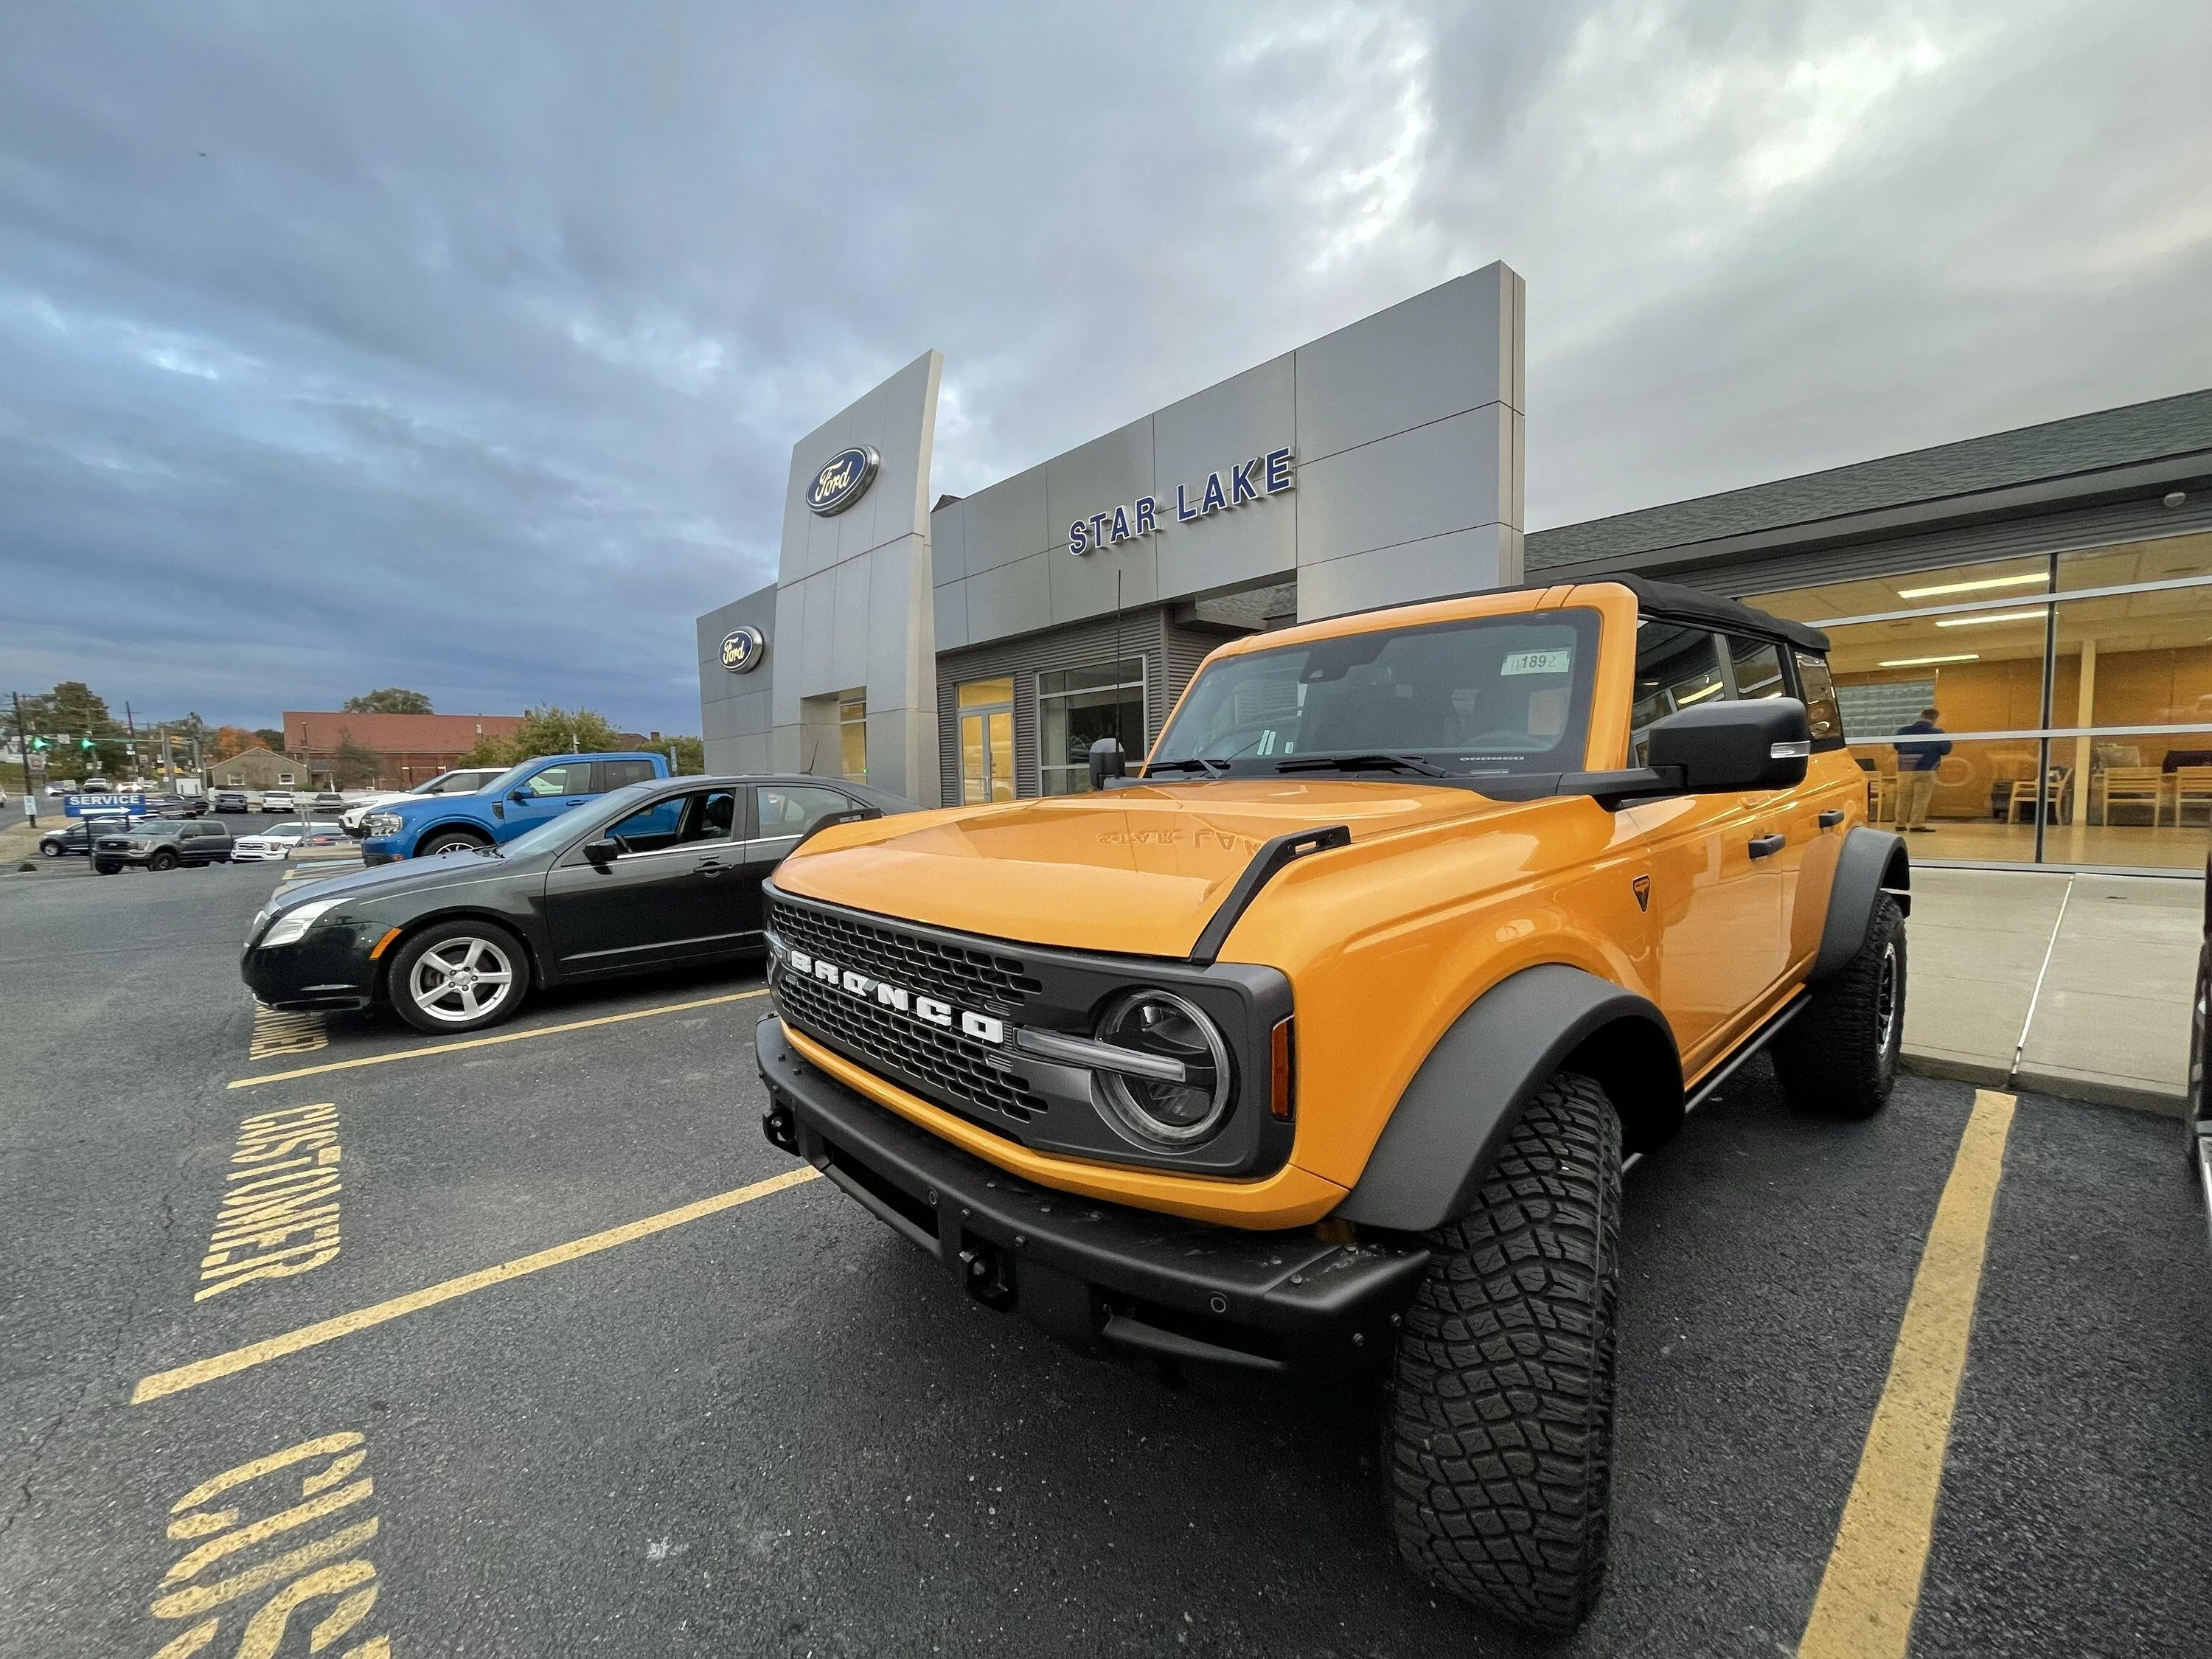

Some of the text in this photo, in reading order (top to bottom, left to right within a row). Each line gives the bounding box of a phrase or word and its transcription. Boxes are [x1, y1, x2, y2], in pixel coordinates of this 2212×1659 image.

[815, 459, 854, 502] Ford
[1069, 445, 1293, 556] STAR LAKE
[723, 636, 745, 665] Ford
[69, 795, 140, 805] SERVICE
[791, 950, 1004, 1044] BRONCO
[194, 1102, 341, 1303] CUSTOMER
